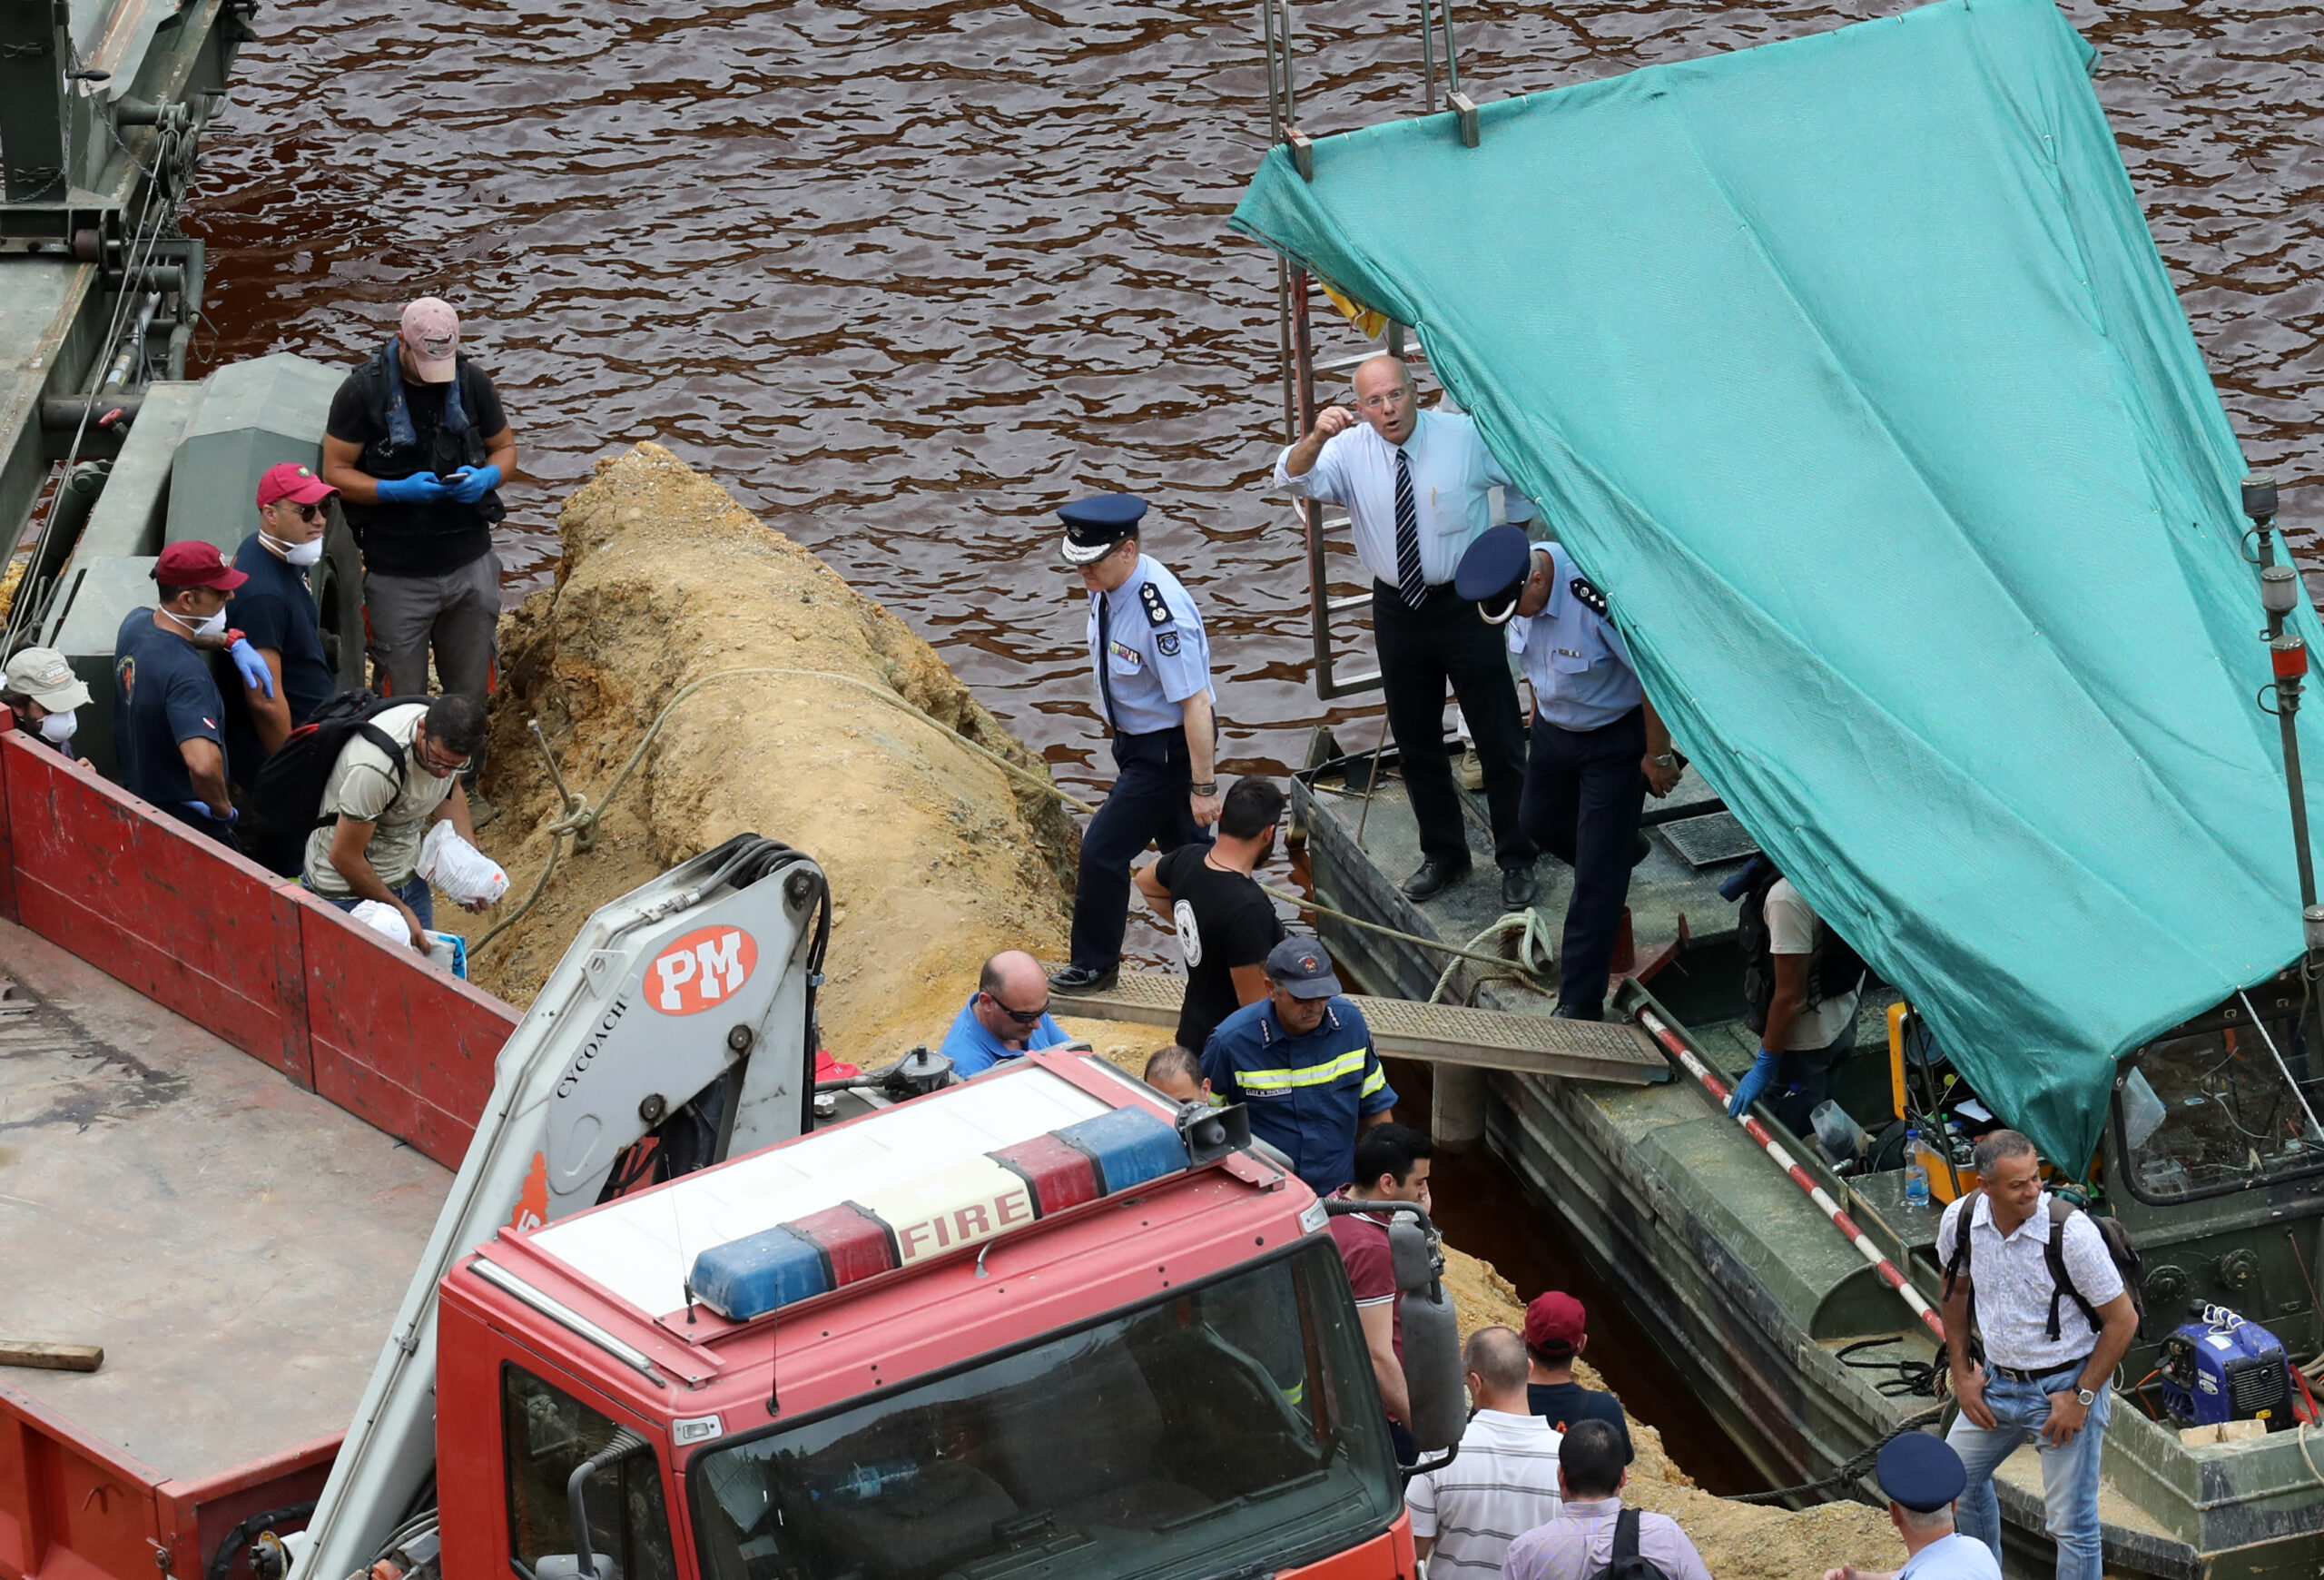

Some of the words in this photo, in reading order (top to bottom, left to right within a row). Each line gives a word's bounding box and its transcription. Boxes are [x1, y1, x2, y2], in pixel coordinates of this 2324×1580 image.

[656, 931, 744, 1010] PM
[556, 1000, 628, 1099] CYCOACH
[899, 1189, 1030, 1259] FIRE
